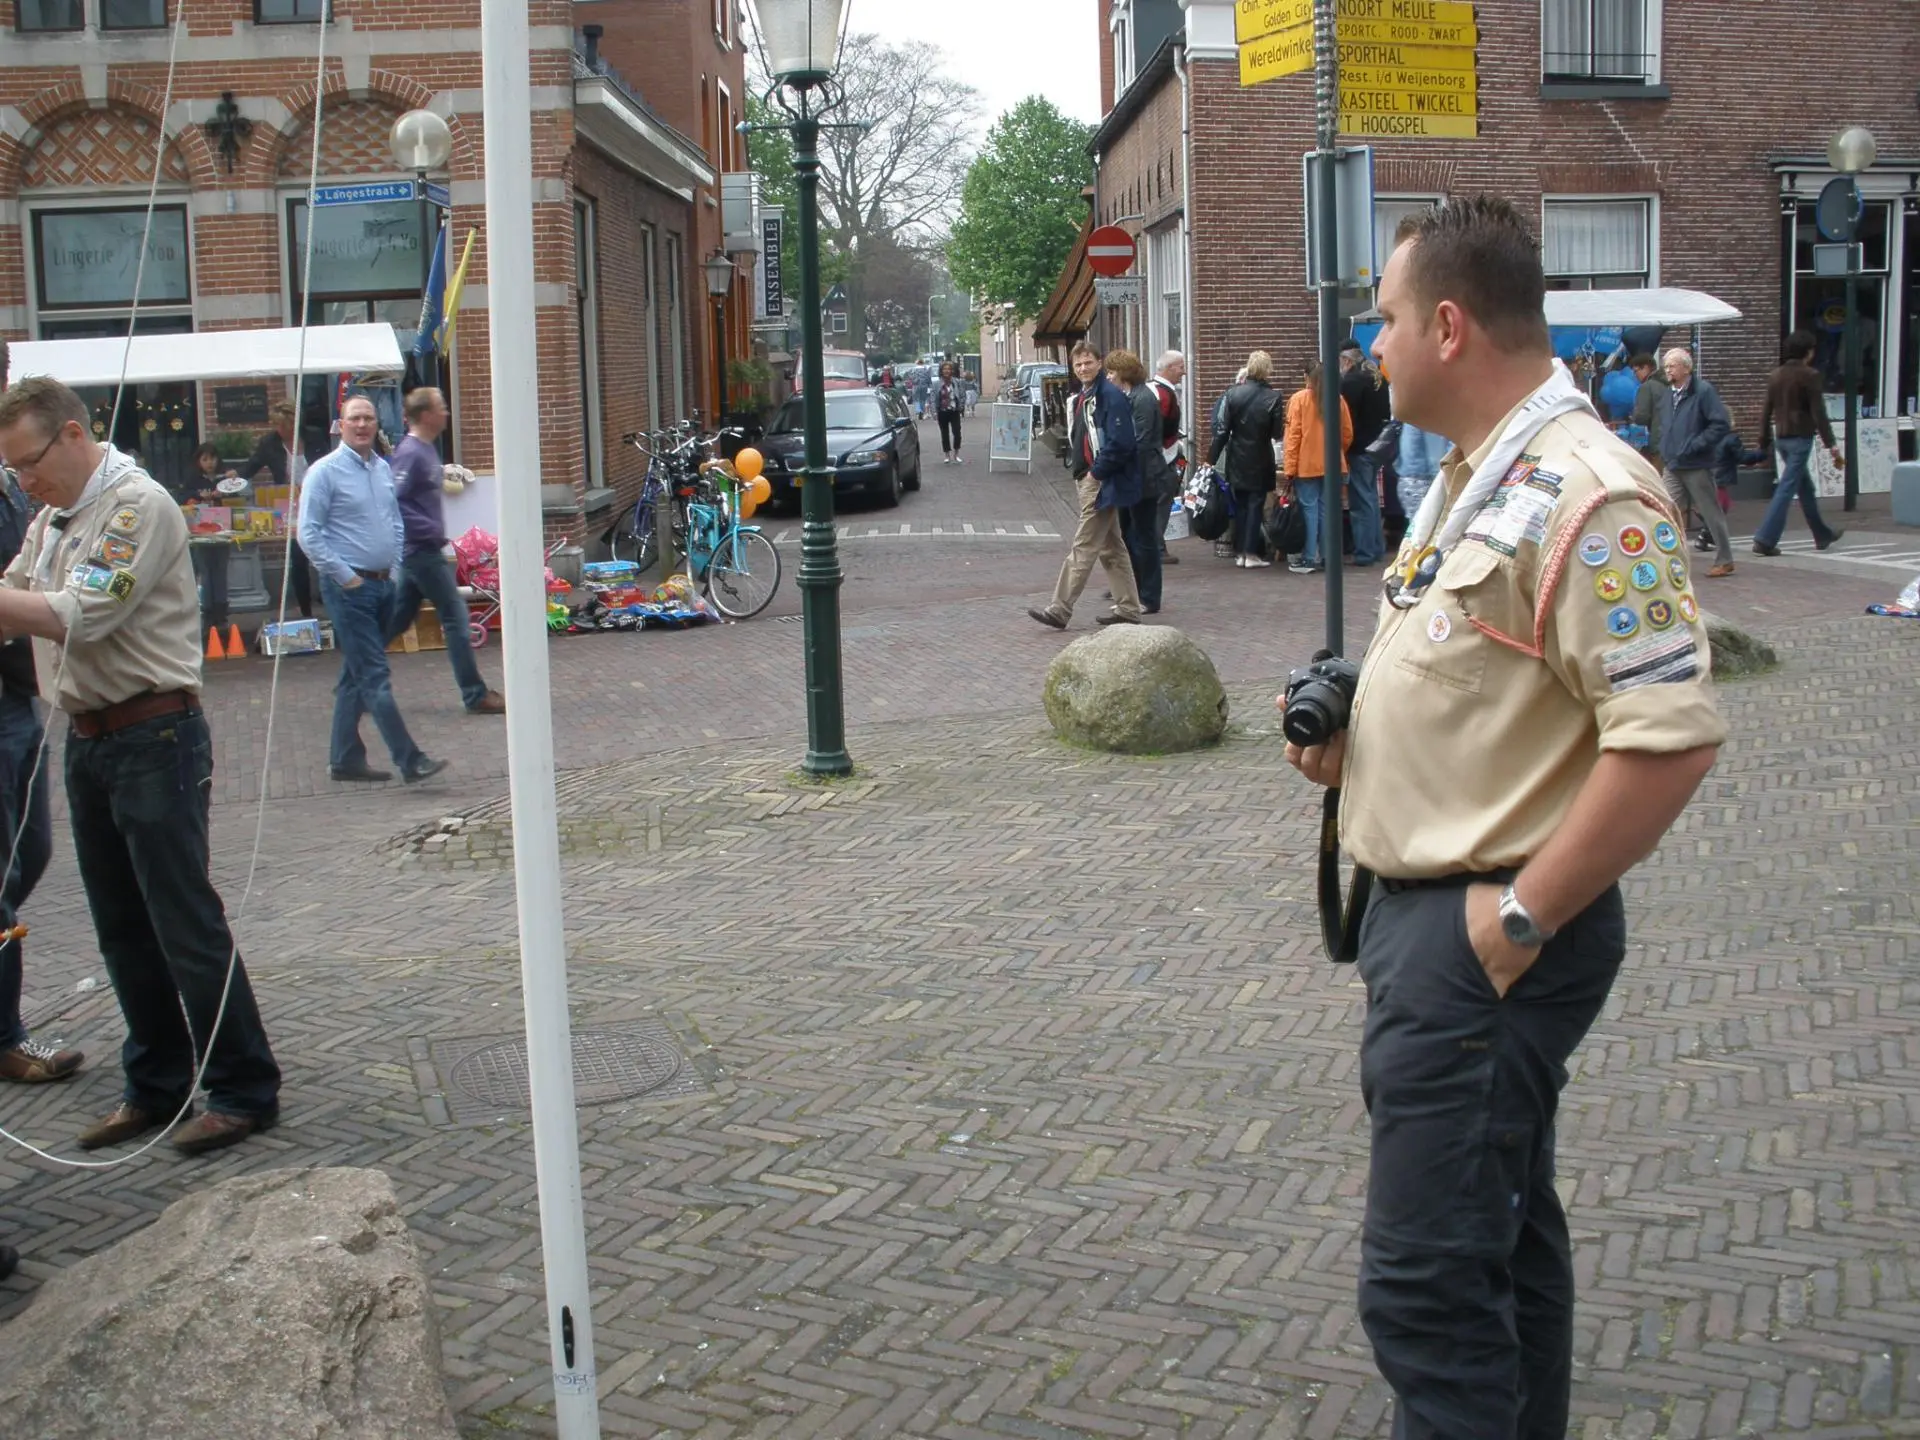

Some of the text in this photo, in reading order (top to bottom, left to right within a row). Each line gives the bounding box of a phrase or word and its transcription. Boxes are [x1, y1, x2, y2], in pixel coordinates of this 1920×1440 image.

[1264, 10, 1291, 28] Golden
[1295, 3, 1312, 19] City
[1337, 0, 1436, 20] NOORT MEULE
[1338, 23, 1381, 38] SPORTC.
[1338, 45, 1405, 65] SPORTHAL
[1339, 69, 1466, 89] Rest. i/d Weijenborg
[1340, 91, 1463, 113] KASTEEL TWICKEL
[1361, 115, 1428, 135] HOOGSPEL
[324, 185, 395, 201] Langestraat
[53, 246, 114, 269] Lingerie
[149, 244, 175, 262] You
[766, 222, 780, 312] ENSEMBLE
